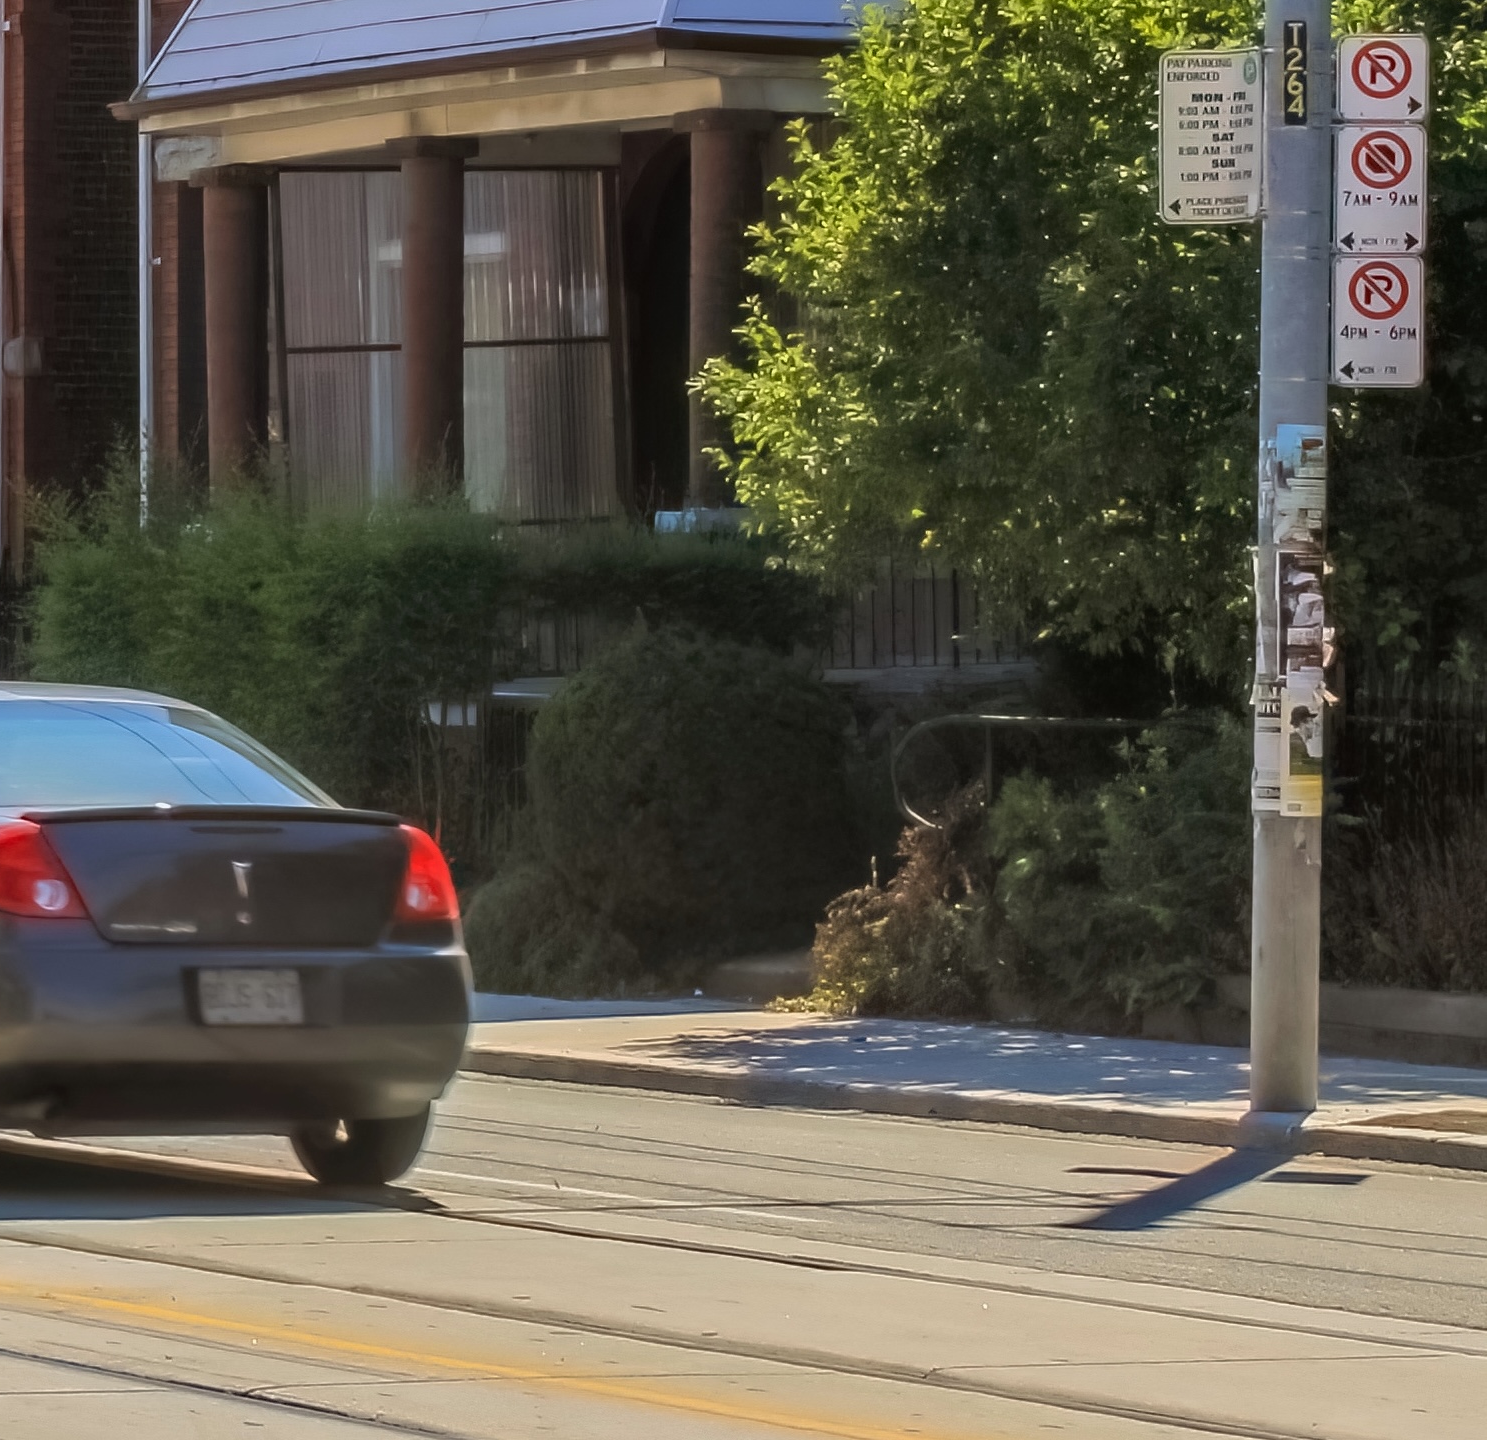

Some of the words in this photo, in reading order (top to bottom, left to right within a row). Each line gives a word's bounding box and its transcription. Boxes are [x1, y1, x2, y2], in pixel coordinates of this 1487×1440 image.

[1287, 23, 1304, 117] T264
[1167, 71, 1220, 82] ENFORCED
[1191, 93, 1223, 103] MON
[1202, 106, 1220, 115] AM
[1202, 119, 1219, 129] PM
[1212, 132, 1235, 142] SAT
[1202, 146, 1220, 155] AM
[1212, 158, 1236, 168] SUN
[1202, 172, 1219, 181] PM
[1343, 191, 1372, 206] 7AM
[1389, 191, 1418, 206] 9AM
[1340, 324, 1368, 339] 4PM
[1389, 324, 1417, 340] 6PM
